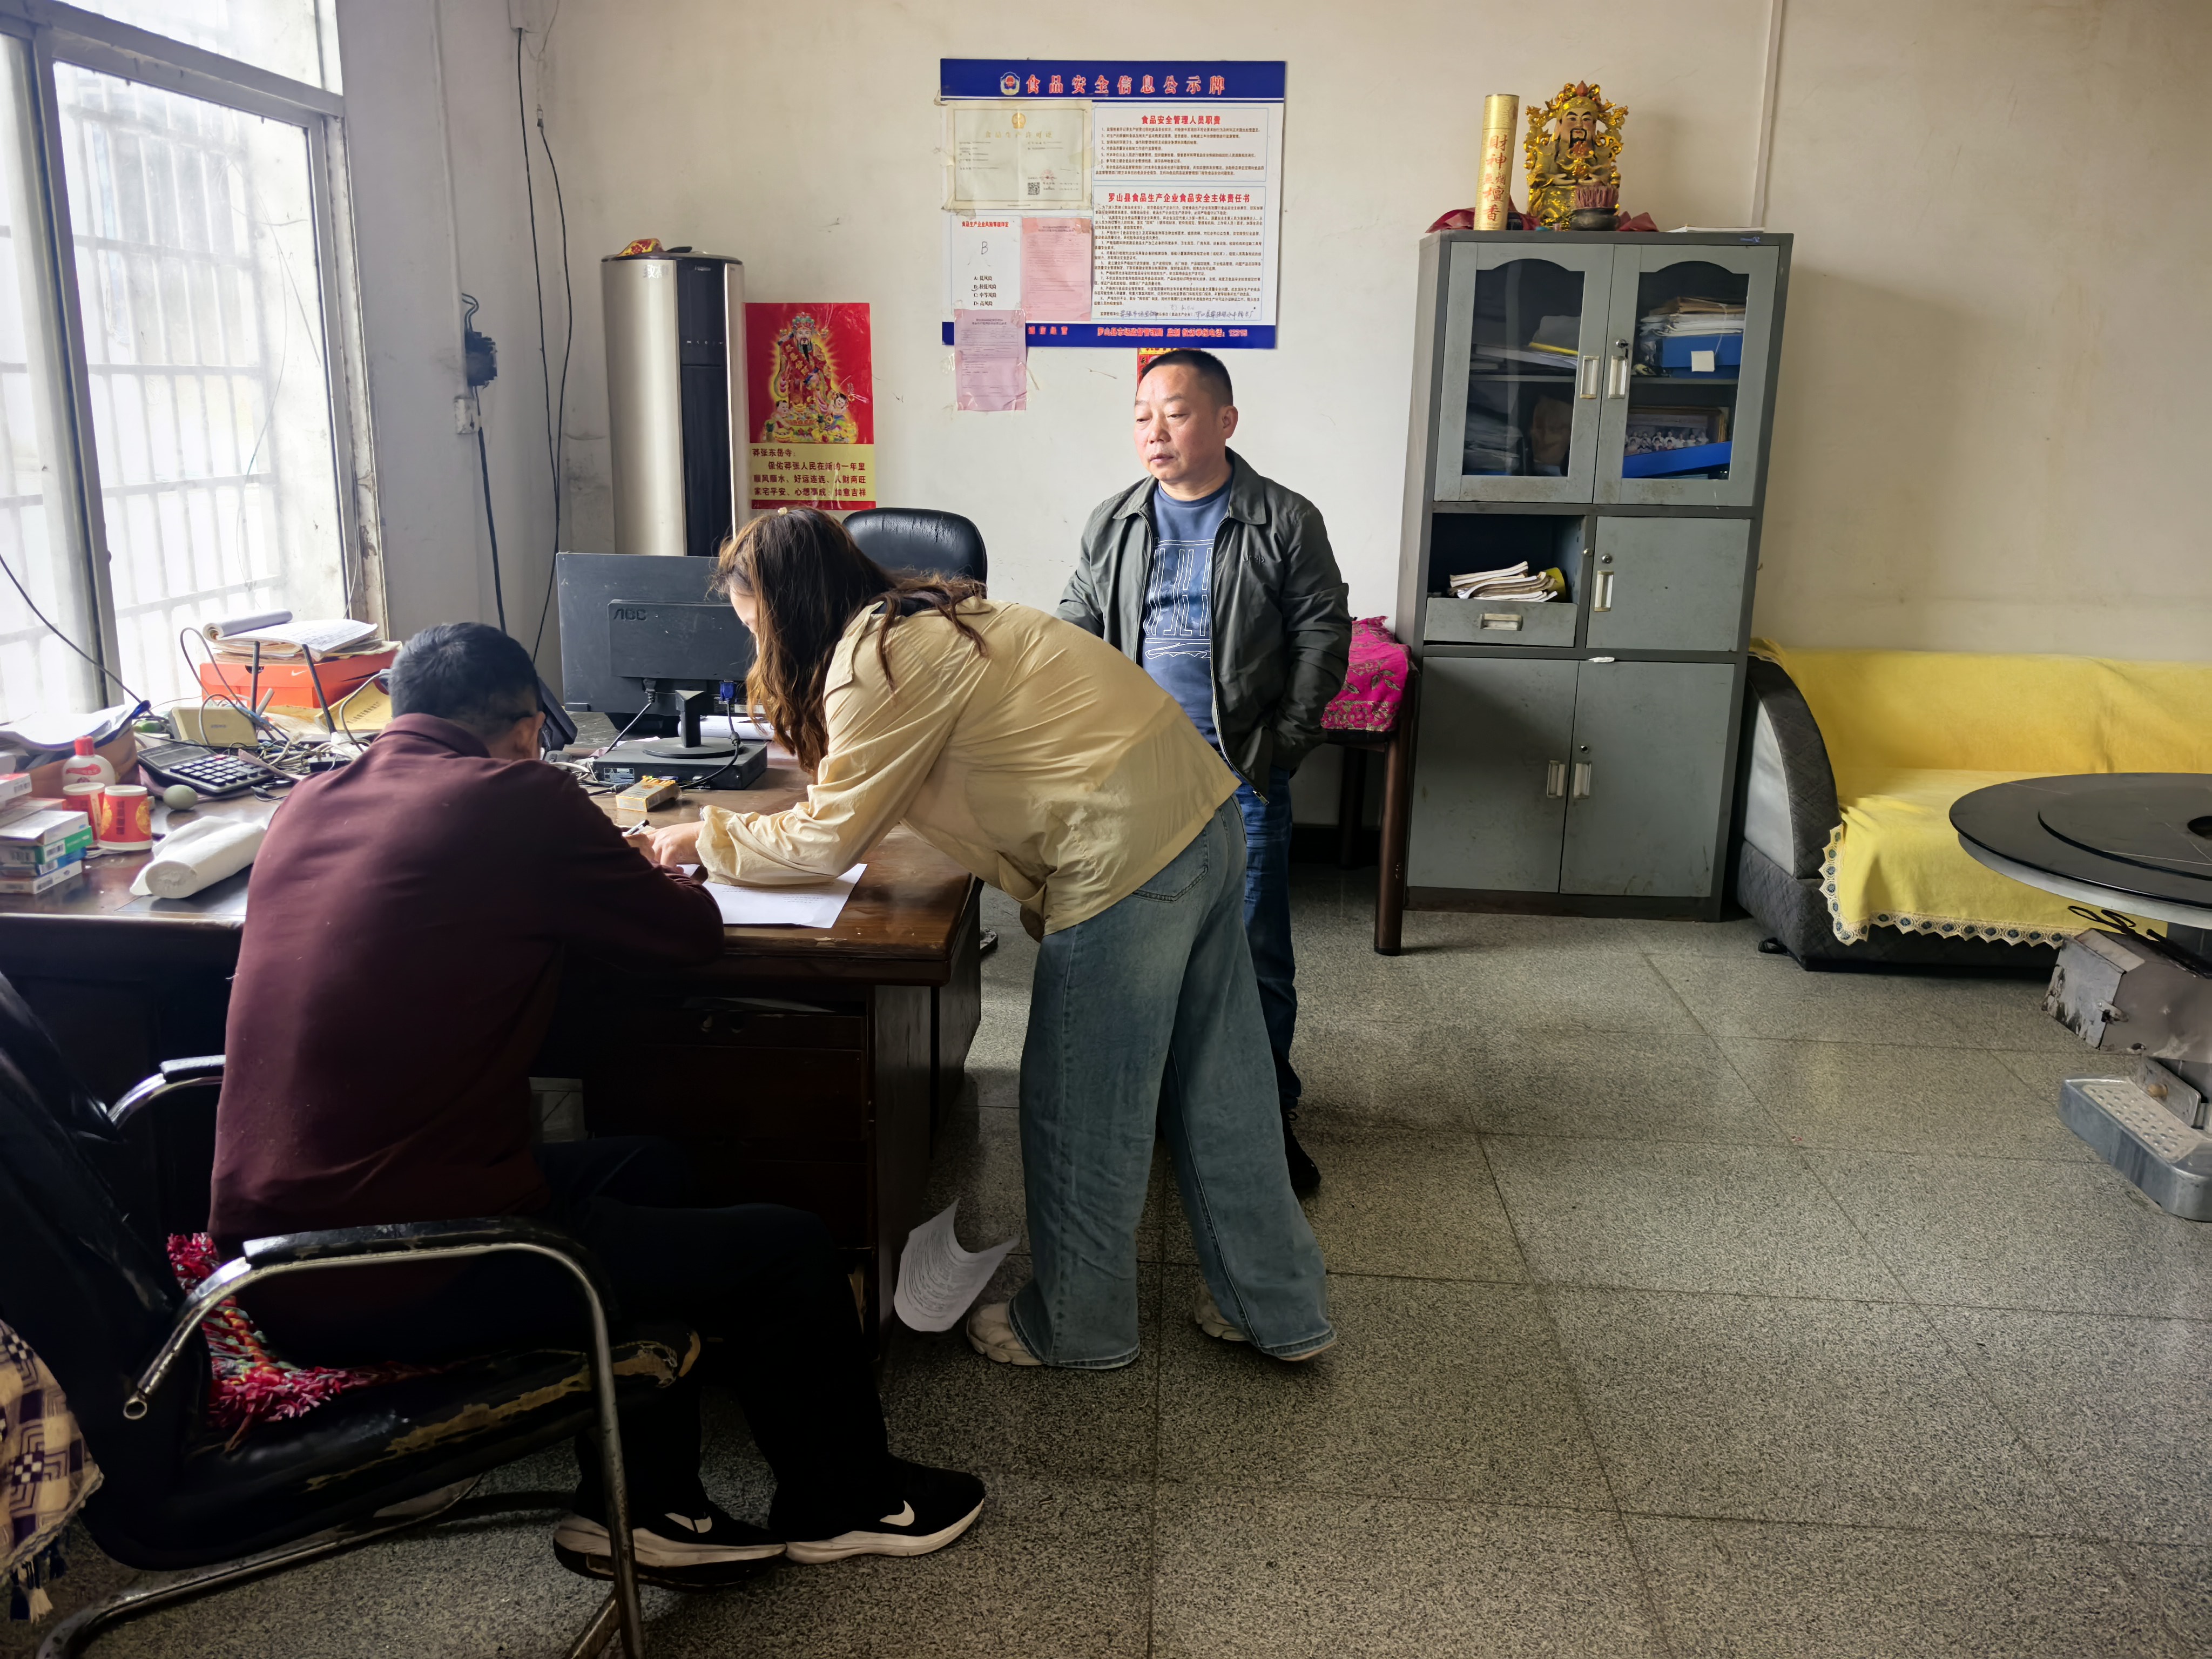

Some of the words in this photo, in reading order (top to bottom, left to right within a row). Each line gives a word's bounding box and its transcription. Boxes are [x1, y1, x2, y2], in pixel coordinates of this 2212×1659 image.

[1026, 75, 1225, 95] 食品安全信息公示牌
[1142, 115, 1220, 125] 食品安全管理人员职责
[1108, 193, 1250, 203] 罗山县食品生产企业食品安全主体责任书
[613, 608, 646, 621] AOC
